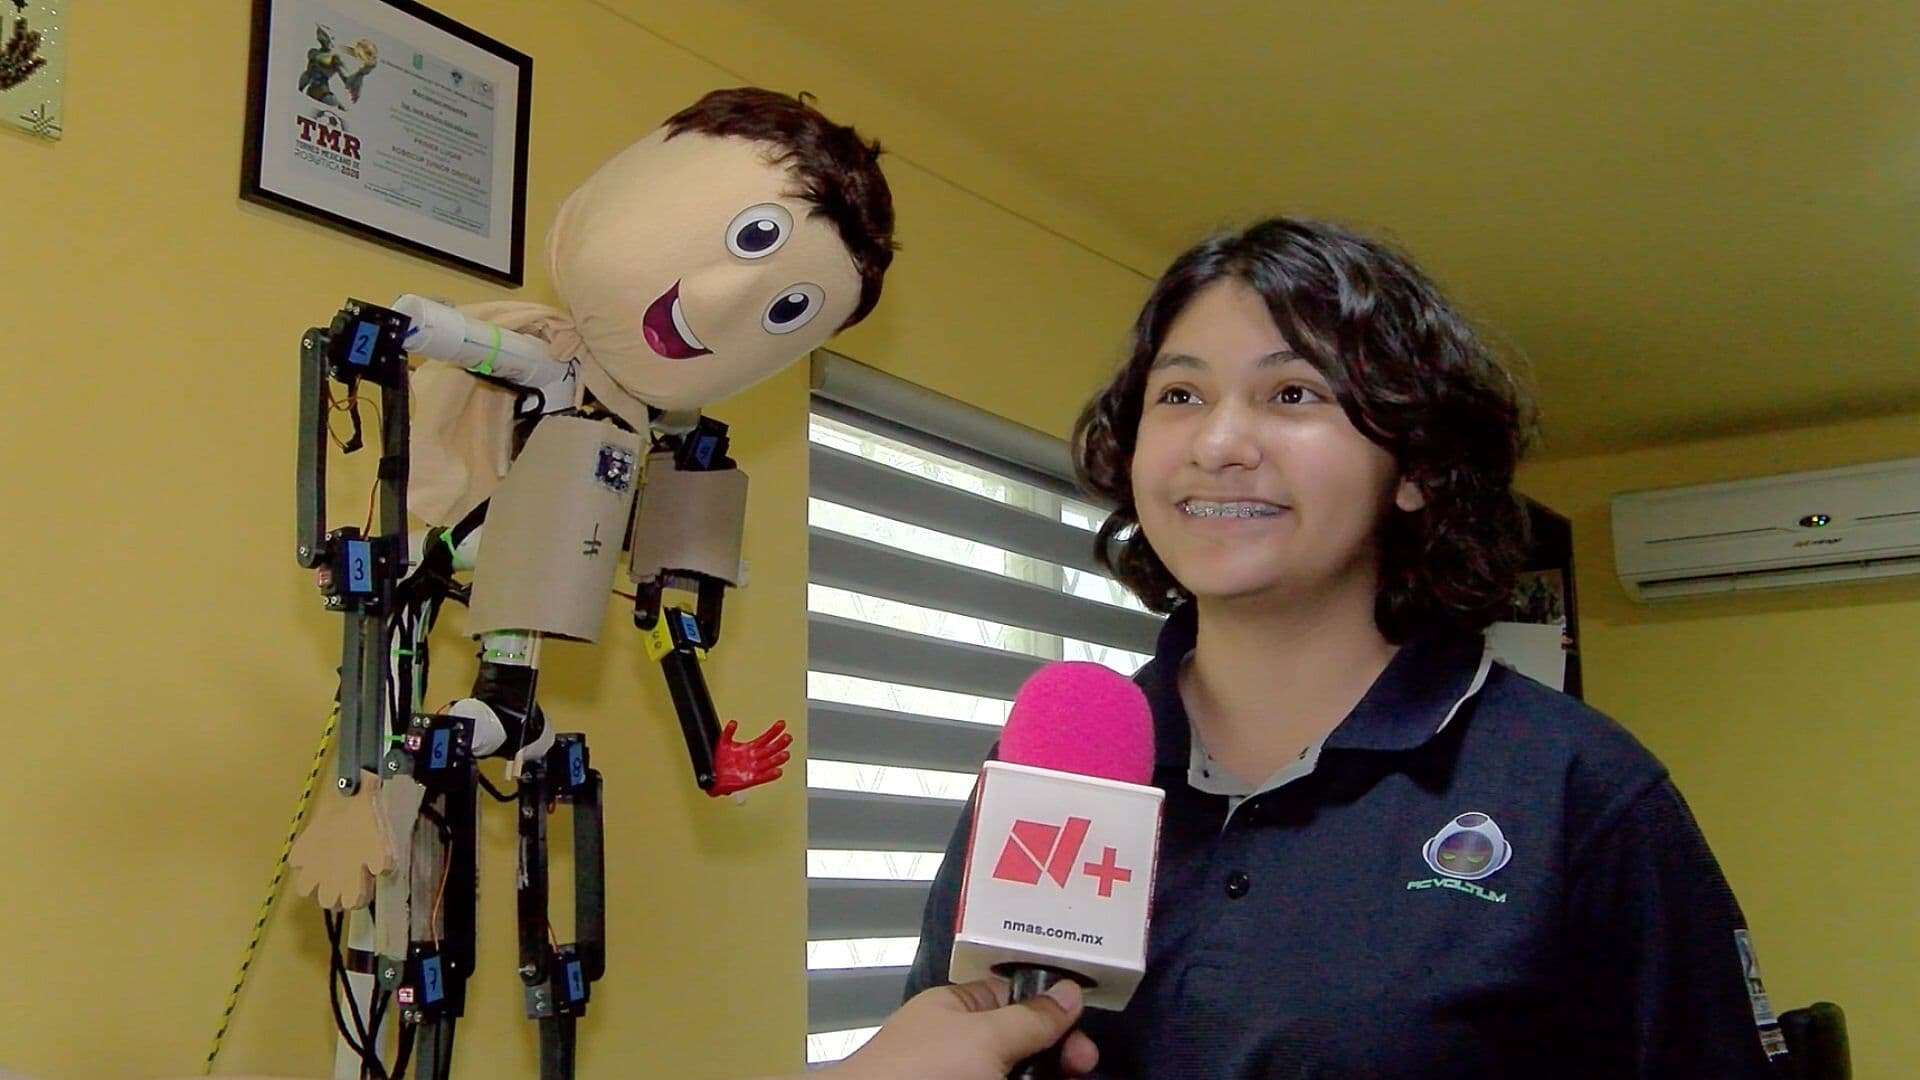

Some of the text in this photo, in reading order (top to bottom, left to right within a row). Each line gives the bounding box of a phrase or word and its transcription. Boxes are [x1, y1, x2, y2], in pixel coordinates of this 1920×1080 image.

[296, 114, 361, 161] TMR
[356, 334, 369, 356] 2
[353, 556, 365, 581] 3
[686, 623, 697, 637] 5
[434, 741, 443, 760] 6
[572, 757, 581, 778] 8
[1003, 919, 1104, 946] nmas.com.mx
